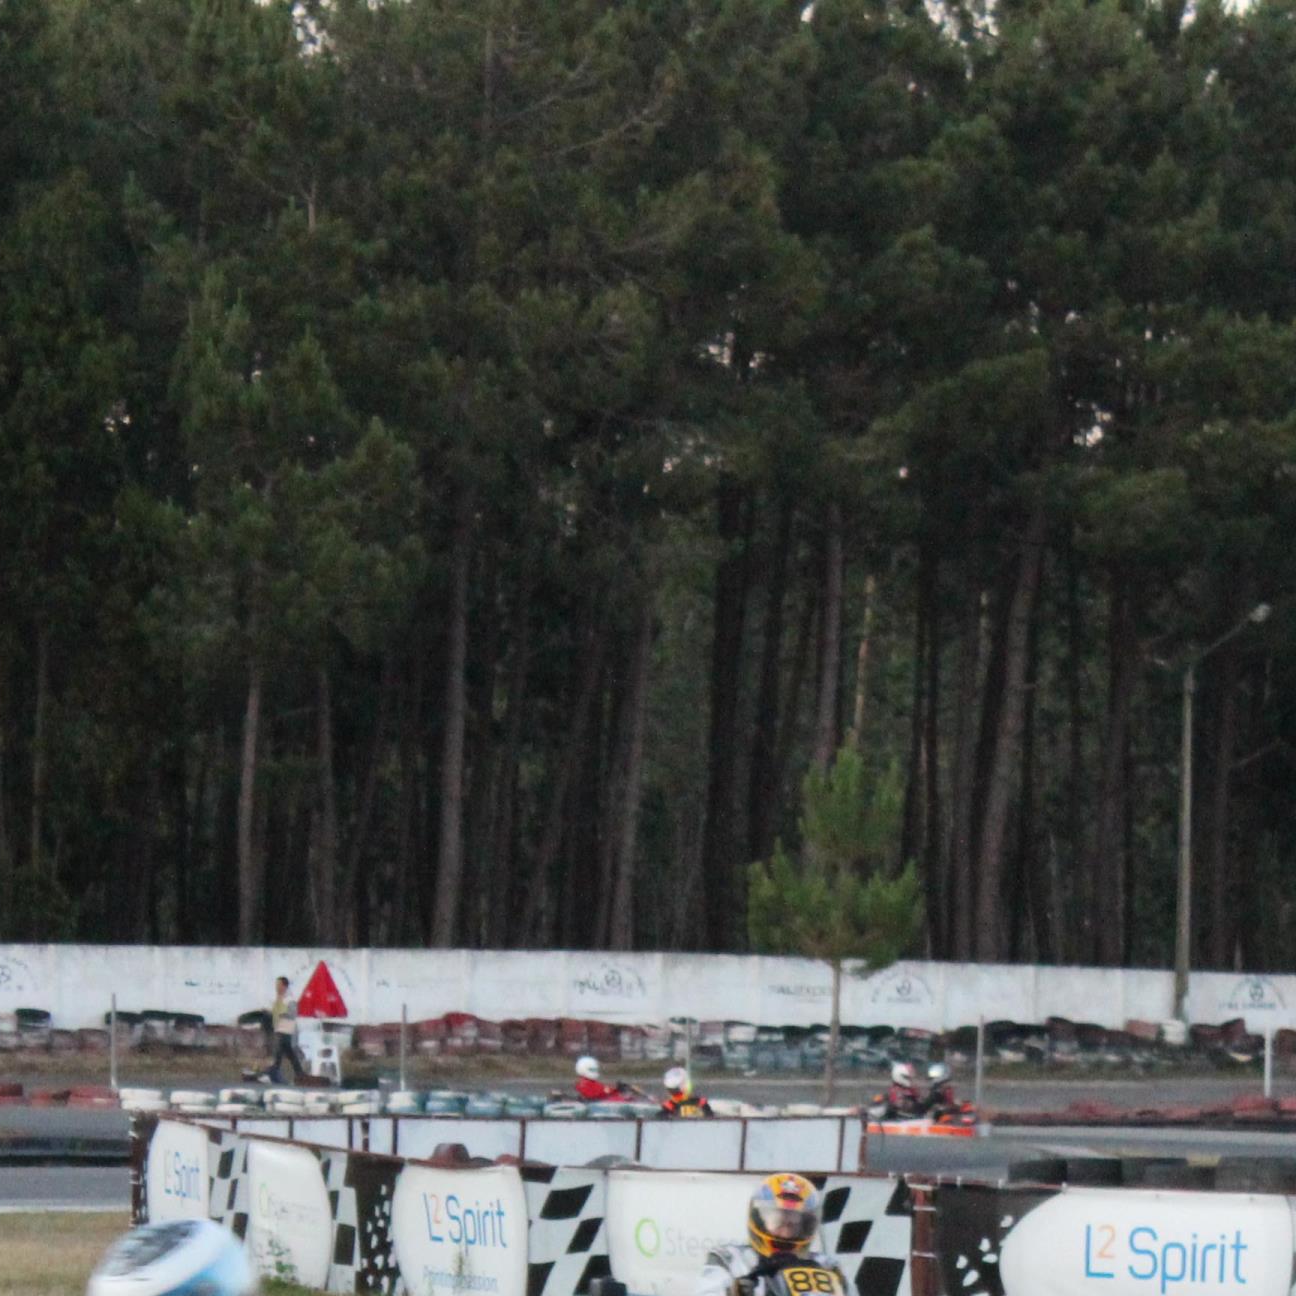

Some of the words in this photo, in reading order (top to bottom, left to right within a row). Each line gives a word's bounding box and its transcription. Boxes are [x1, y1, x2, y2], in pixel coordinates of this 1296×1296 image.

[445, 1194, 508, 1257] Spirit
[789, 1270, 835, 1293] 88
[1127, 1226, 1249, 1296] Spirit
